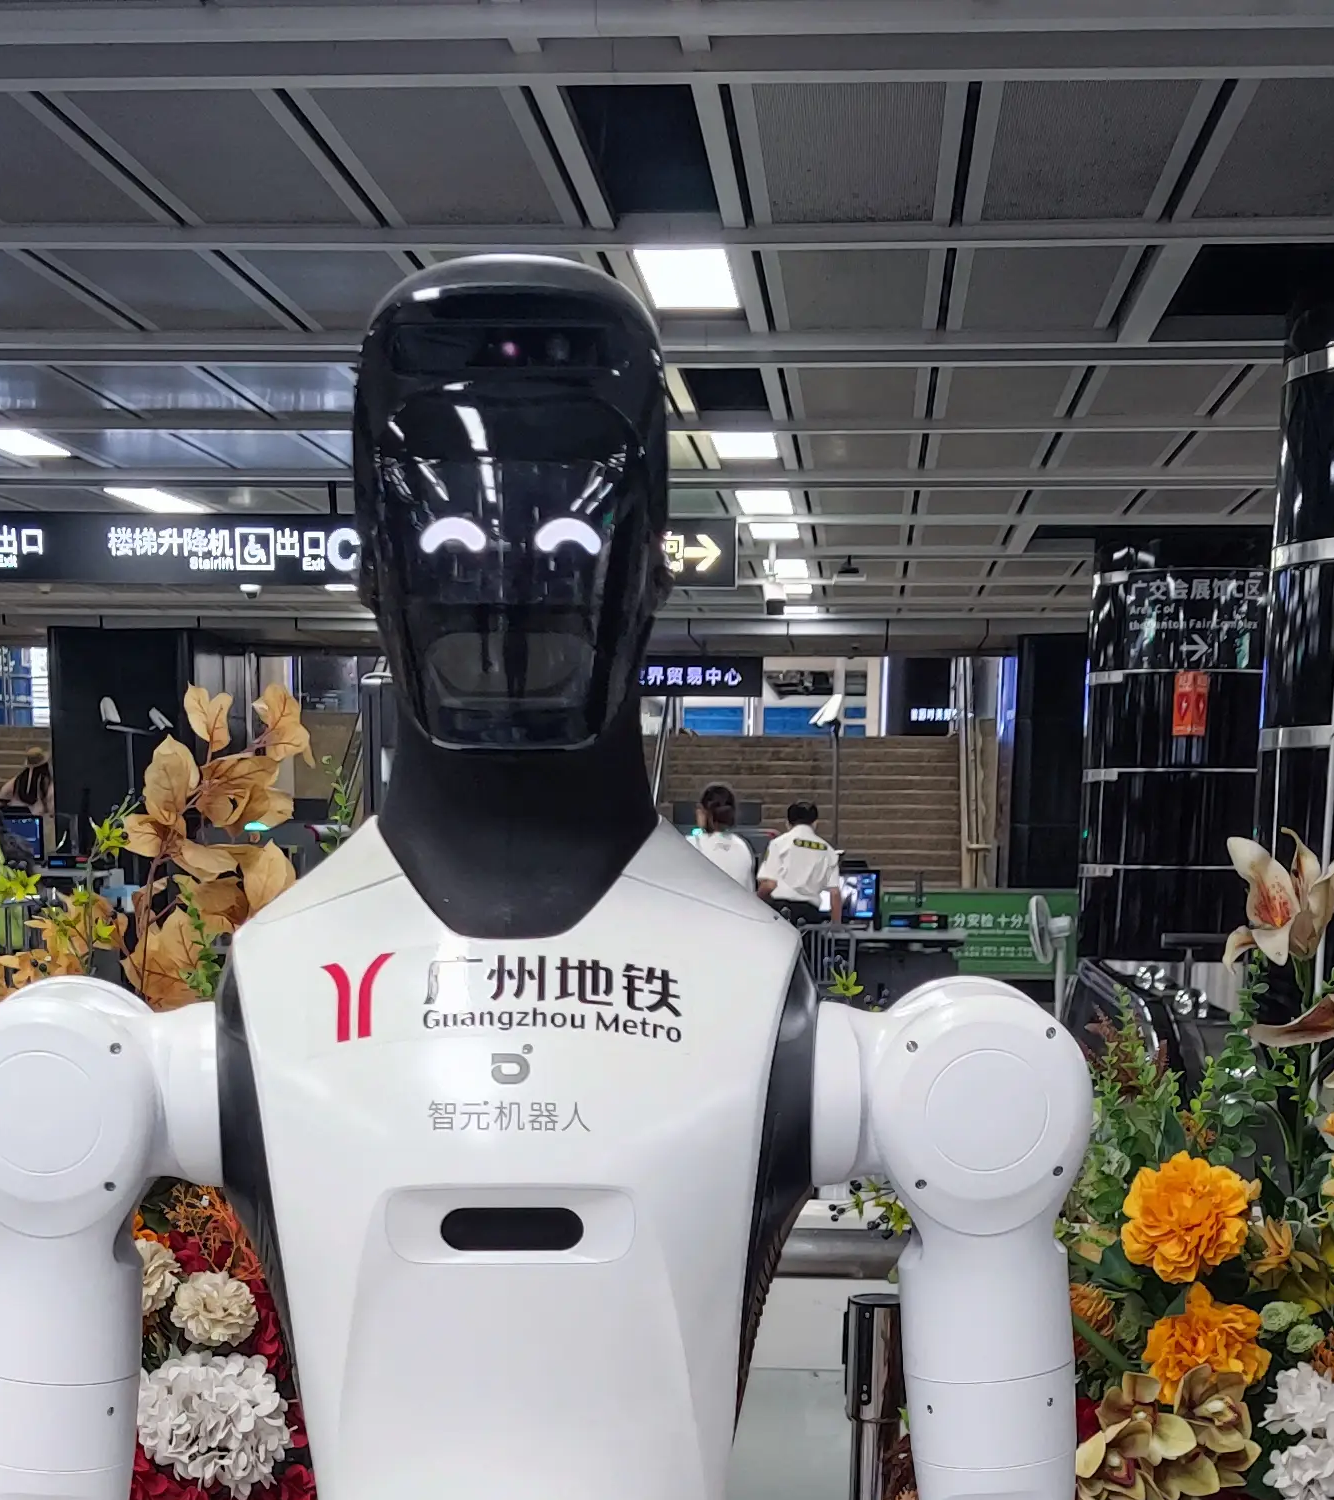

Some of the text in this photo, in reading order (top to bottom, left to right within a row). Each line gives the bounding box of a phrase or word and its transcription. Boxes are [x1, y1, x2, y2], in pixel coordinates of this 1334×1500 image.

[107, 527, 361, 571] 楼梯升降机 出口 C
[303, 557, 326, 571] Exit
[948, 912, 993, 928] 分安检
[424, 955, 682, 1018] 广州地铁
[423, 1008, 683, 1043] Guangzhou Metro
[427, 1100, 592, 1133] 智元机器人
